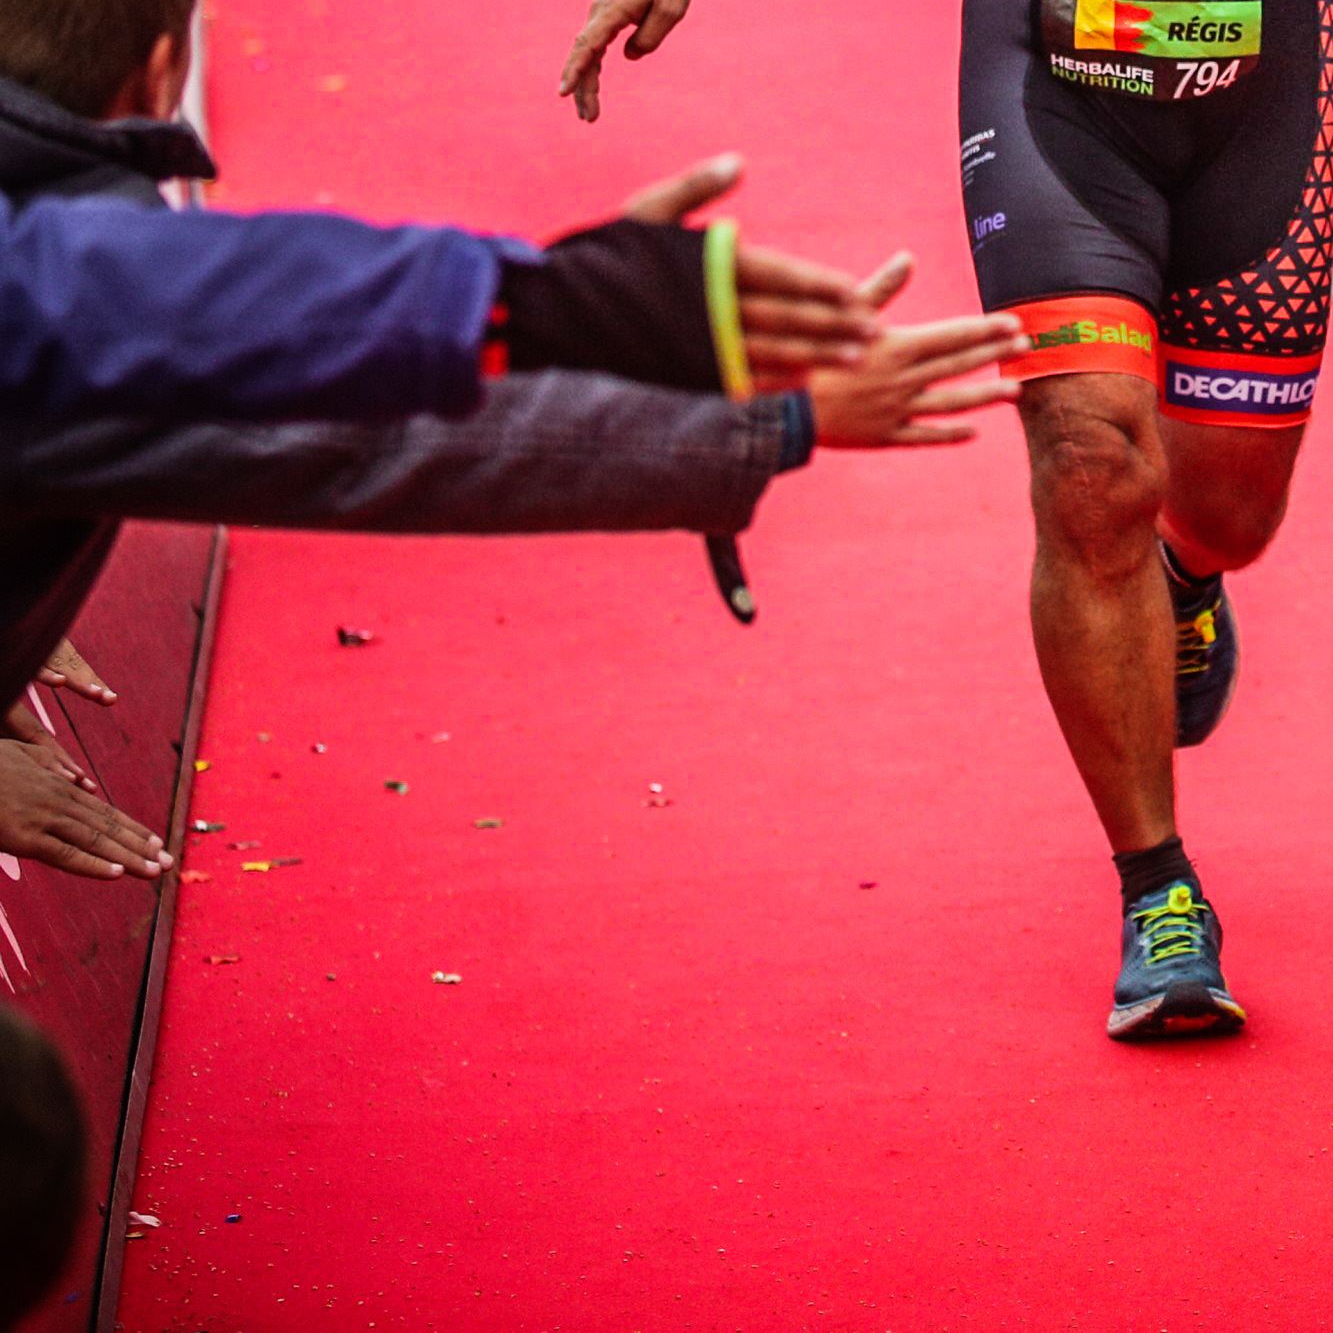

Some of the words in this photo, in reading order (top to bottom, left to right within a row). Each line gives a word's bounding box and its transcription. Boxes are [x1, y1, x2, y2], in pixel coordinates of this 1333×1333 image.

[1168, 16, 1243, 43] RÉGIS
[1050, 53, 1154, 84] HERBALIFE
[1051, 66, 1154, 96] NUTRITION
[1173, 58, 1241, 100] 794
